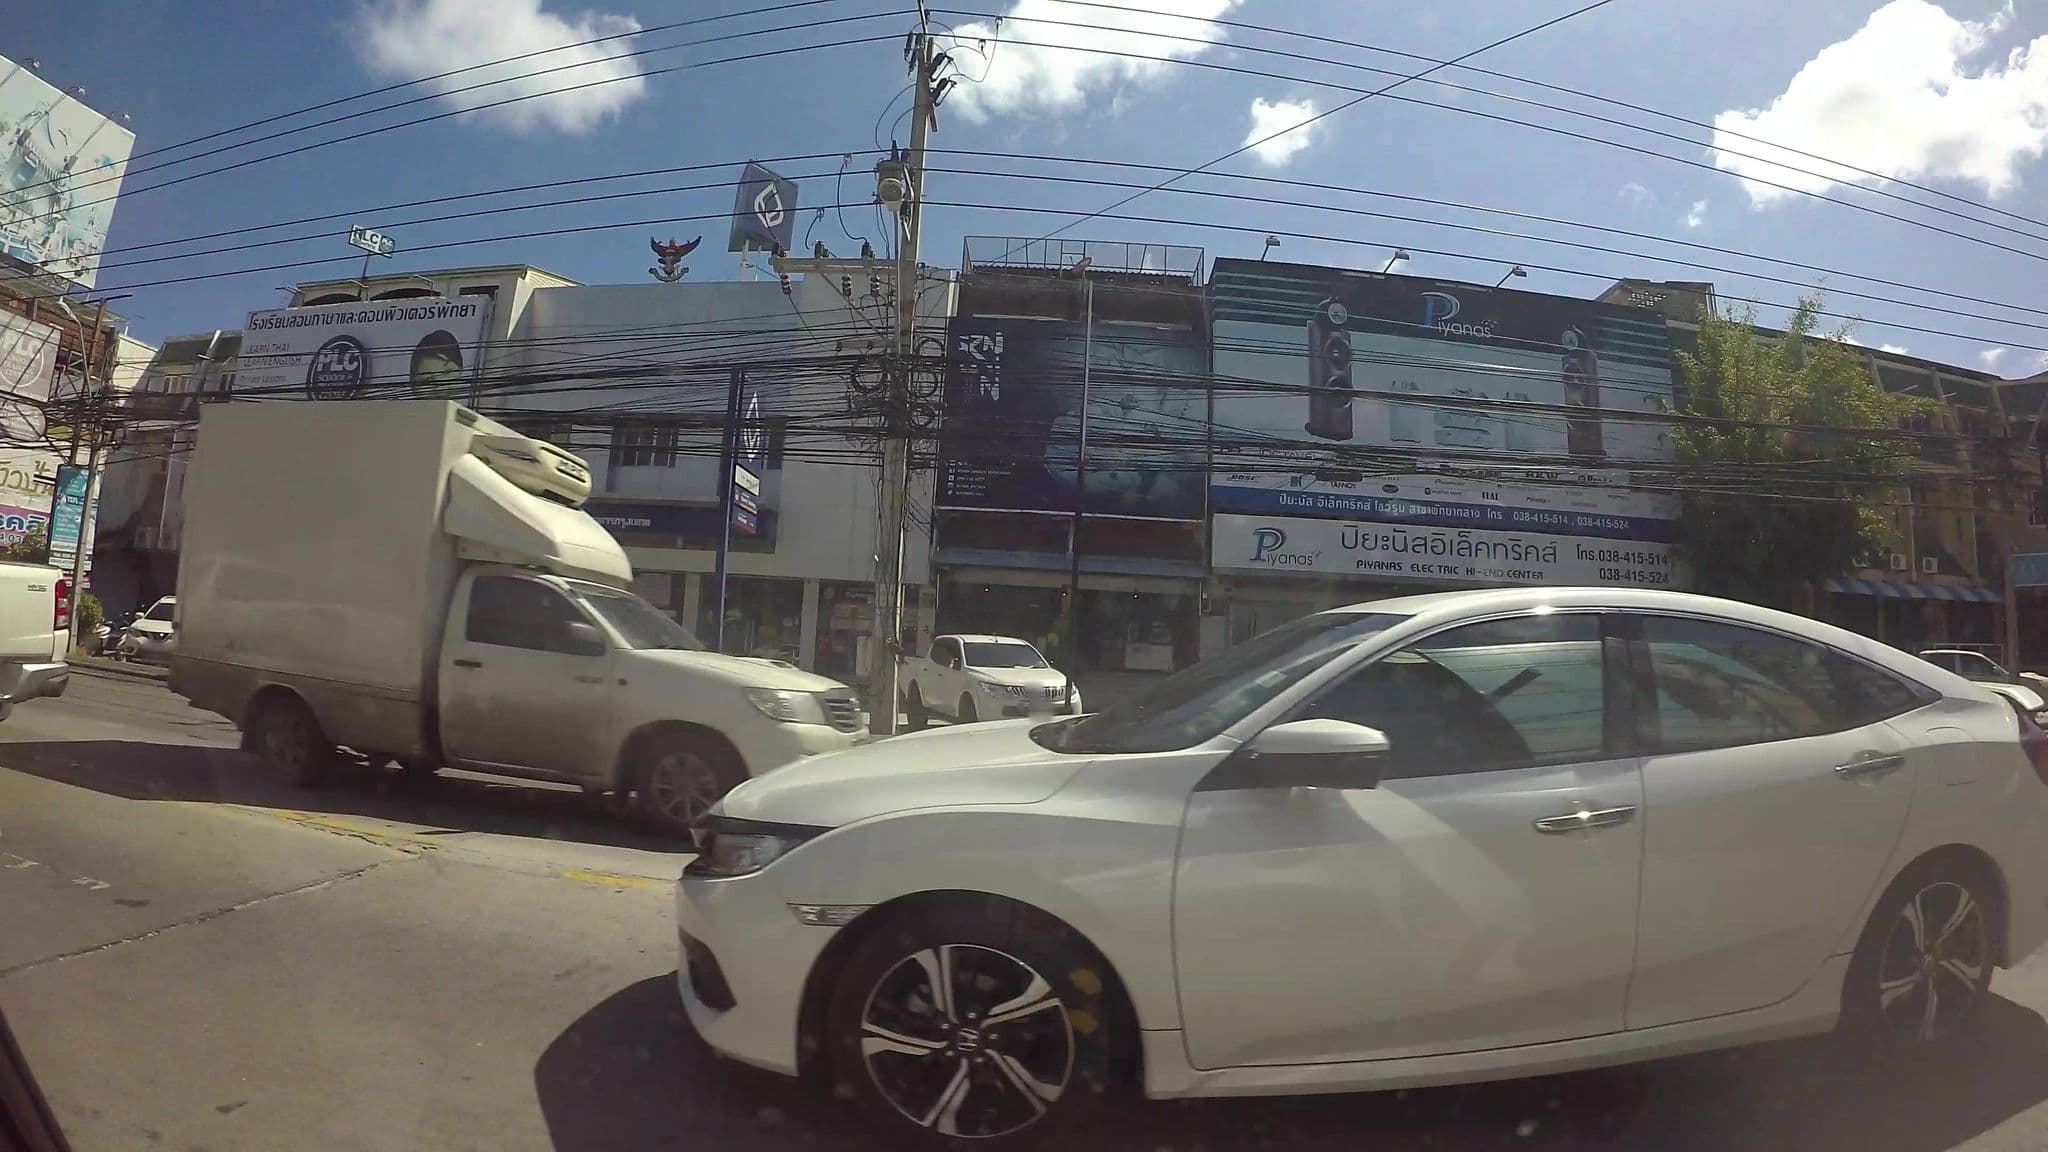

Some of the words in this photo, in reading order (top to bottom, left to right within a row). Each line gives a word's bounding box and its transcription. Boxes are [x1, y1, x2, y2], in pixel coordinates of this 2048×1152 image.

[317, 347, 360, 372] PLC
[1513, 511, 1569, 525] 038-415-514
[1577, 516, 1629, 529] 038-415-524
[1249, 527, 1313, 567] Piyanas
[1356, 559, 1403, 572] PIYANAS
[1507, 569, 1544, 581] CENTER
[1599, 567, 1669, 585] 038-415-524
